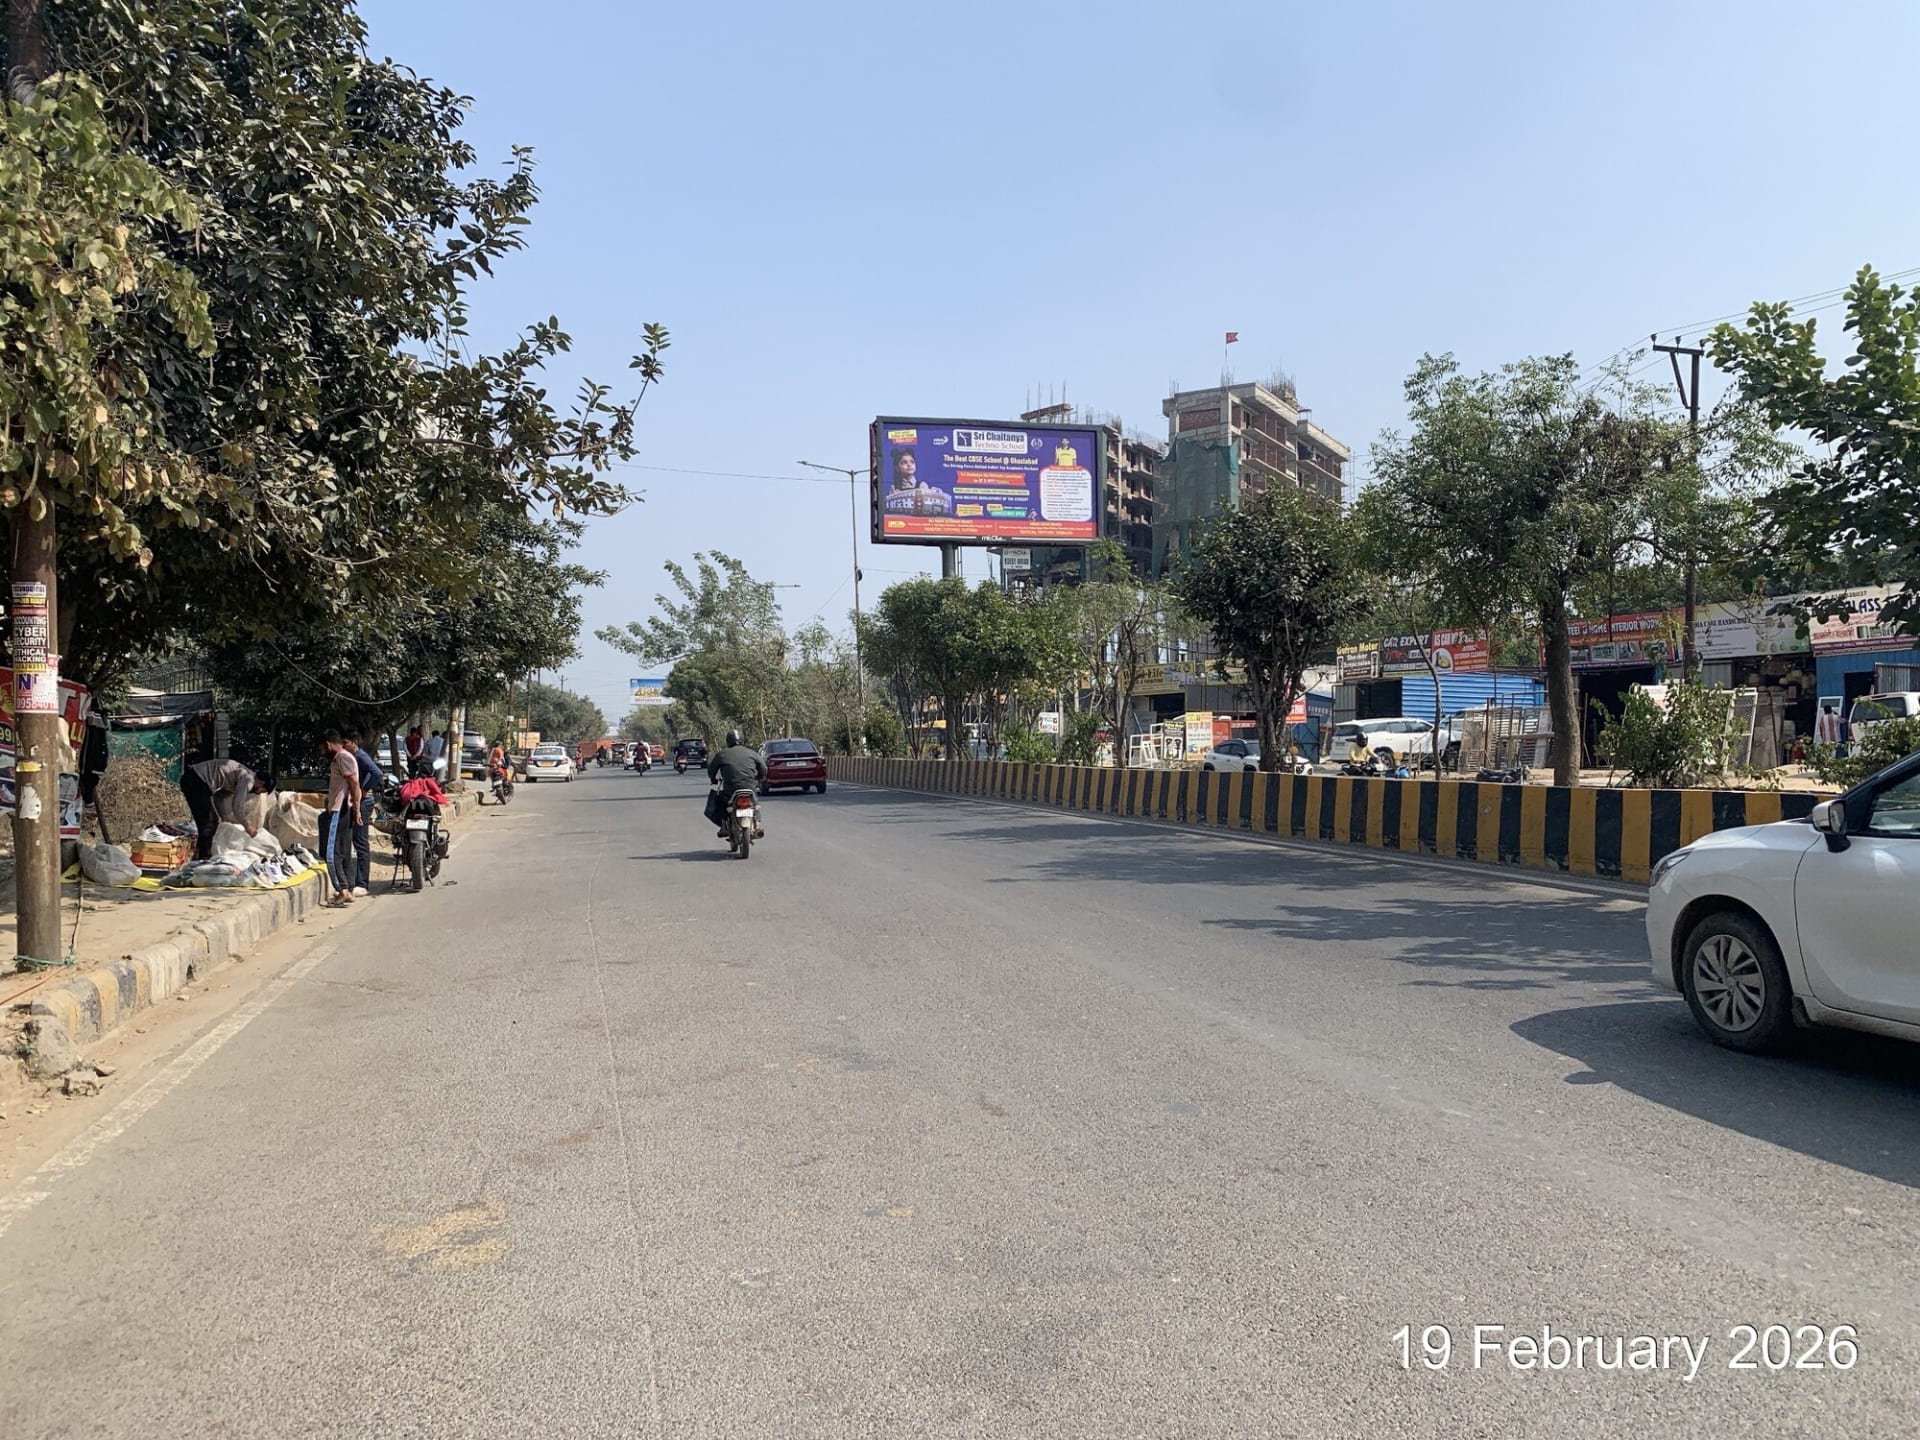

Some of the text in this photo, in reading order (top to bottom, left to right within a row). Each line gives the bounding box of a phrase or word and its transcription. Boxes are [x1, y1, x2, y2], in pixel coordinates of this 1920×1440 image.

[973, 432, 1025, 444] Sri Chaitanya
[974, 441, 1025, 451] Techno School
[944, 454, 954, 462] The
[984, 456, 1003, 464] School
[14, 626, 46, 637] CYBER
[1610, 620, 1639, 634] NTERIOR
[14, 637, 46, 646] SECURITY
[14, 648, 46, 656] ETHICAL
